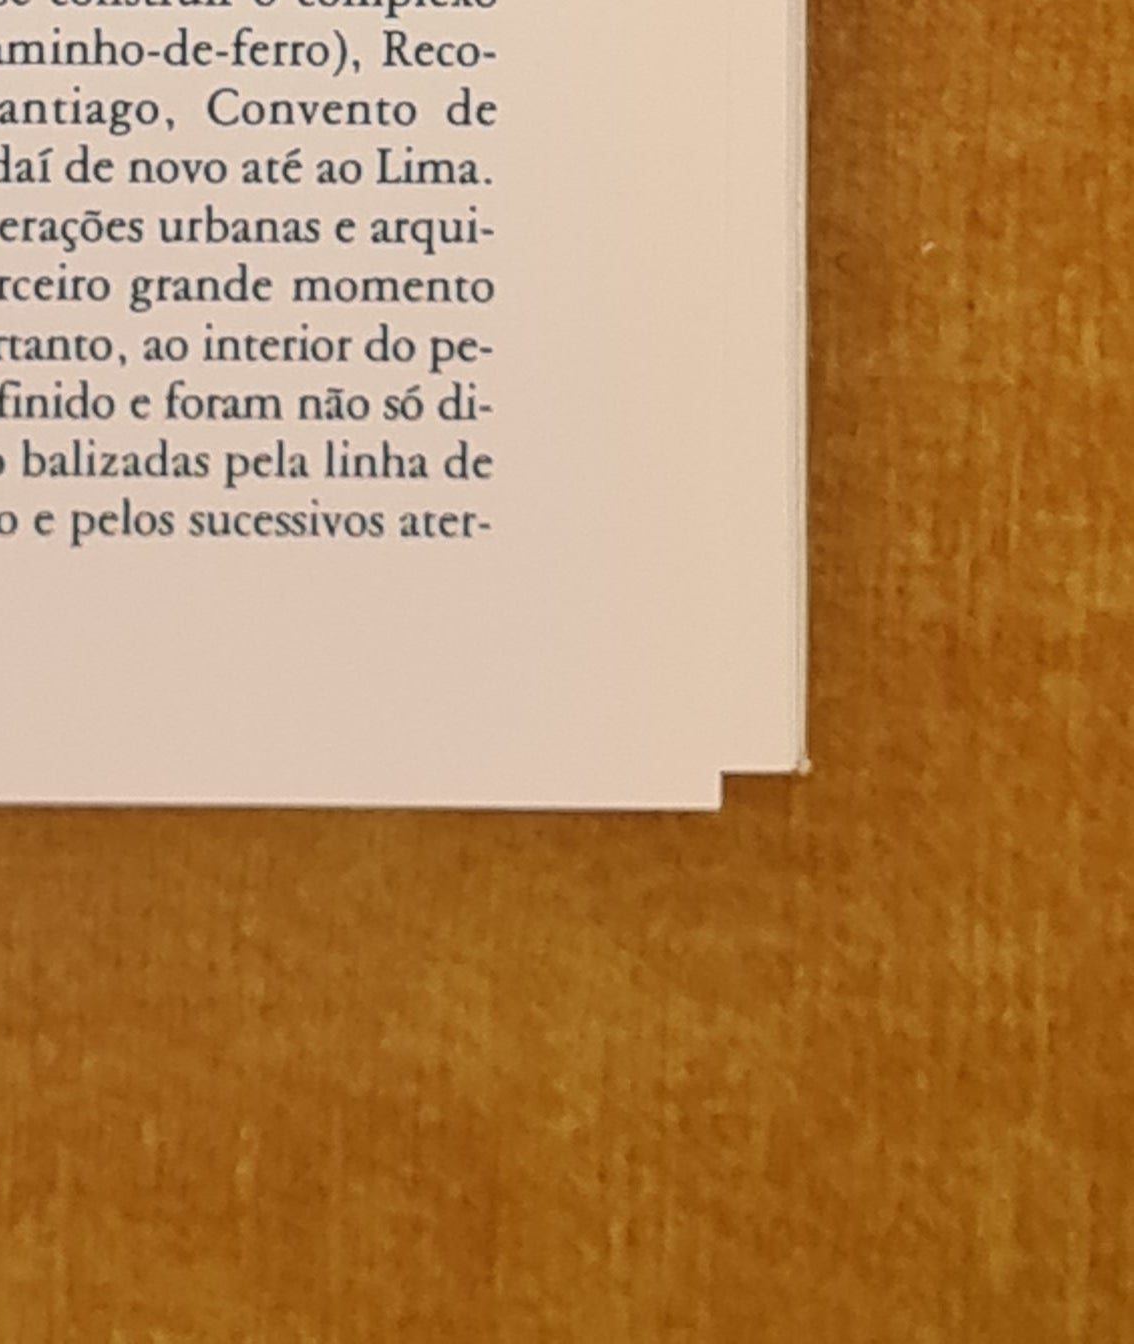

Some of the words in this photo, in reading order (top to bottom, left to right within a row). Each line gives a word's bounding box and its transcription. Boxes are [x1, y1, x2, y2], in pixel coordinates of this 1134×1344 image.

[206, 86, 418, 127] Convento
[445, 85, 498, 127] de
[64, 143, 115, 185] de
[127, 157, 228, 185] novo
[241, 147, 304, 186] até
[315, 158, 363, 186] ao
[375, 145, 493, 186] Lima.
[128, 261, 274, 314] grande
[291, 275, 495, 304] momento
[142, 335, 189, 362] ao
[202, 322, 353, 363] interior
[363, 322, 417, 363] do
[427, 335, 493, 376] pe-
[21, 437, 211, 479] balizadas
[223, 438, 310, 490] pela
[324, 438, 430, 480] linha
[443, 439, 494, 481] de
